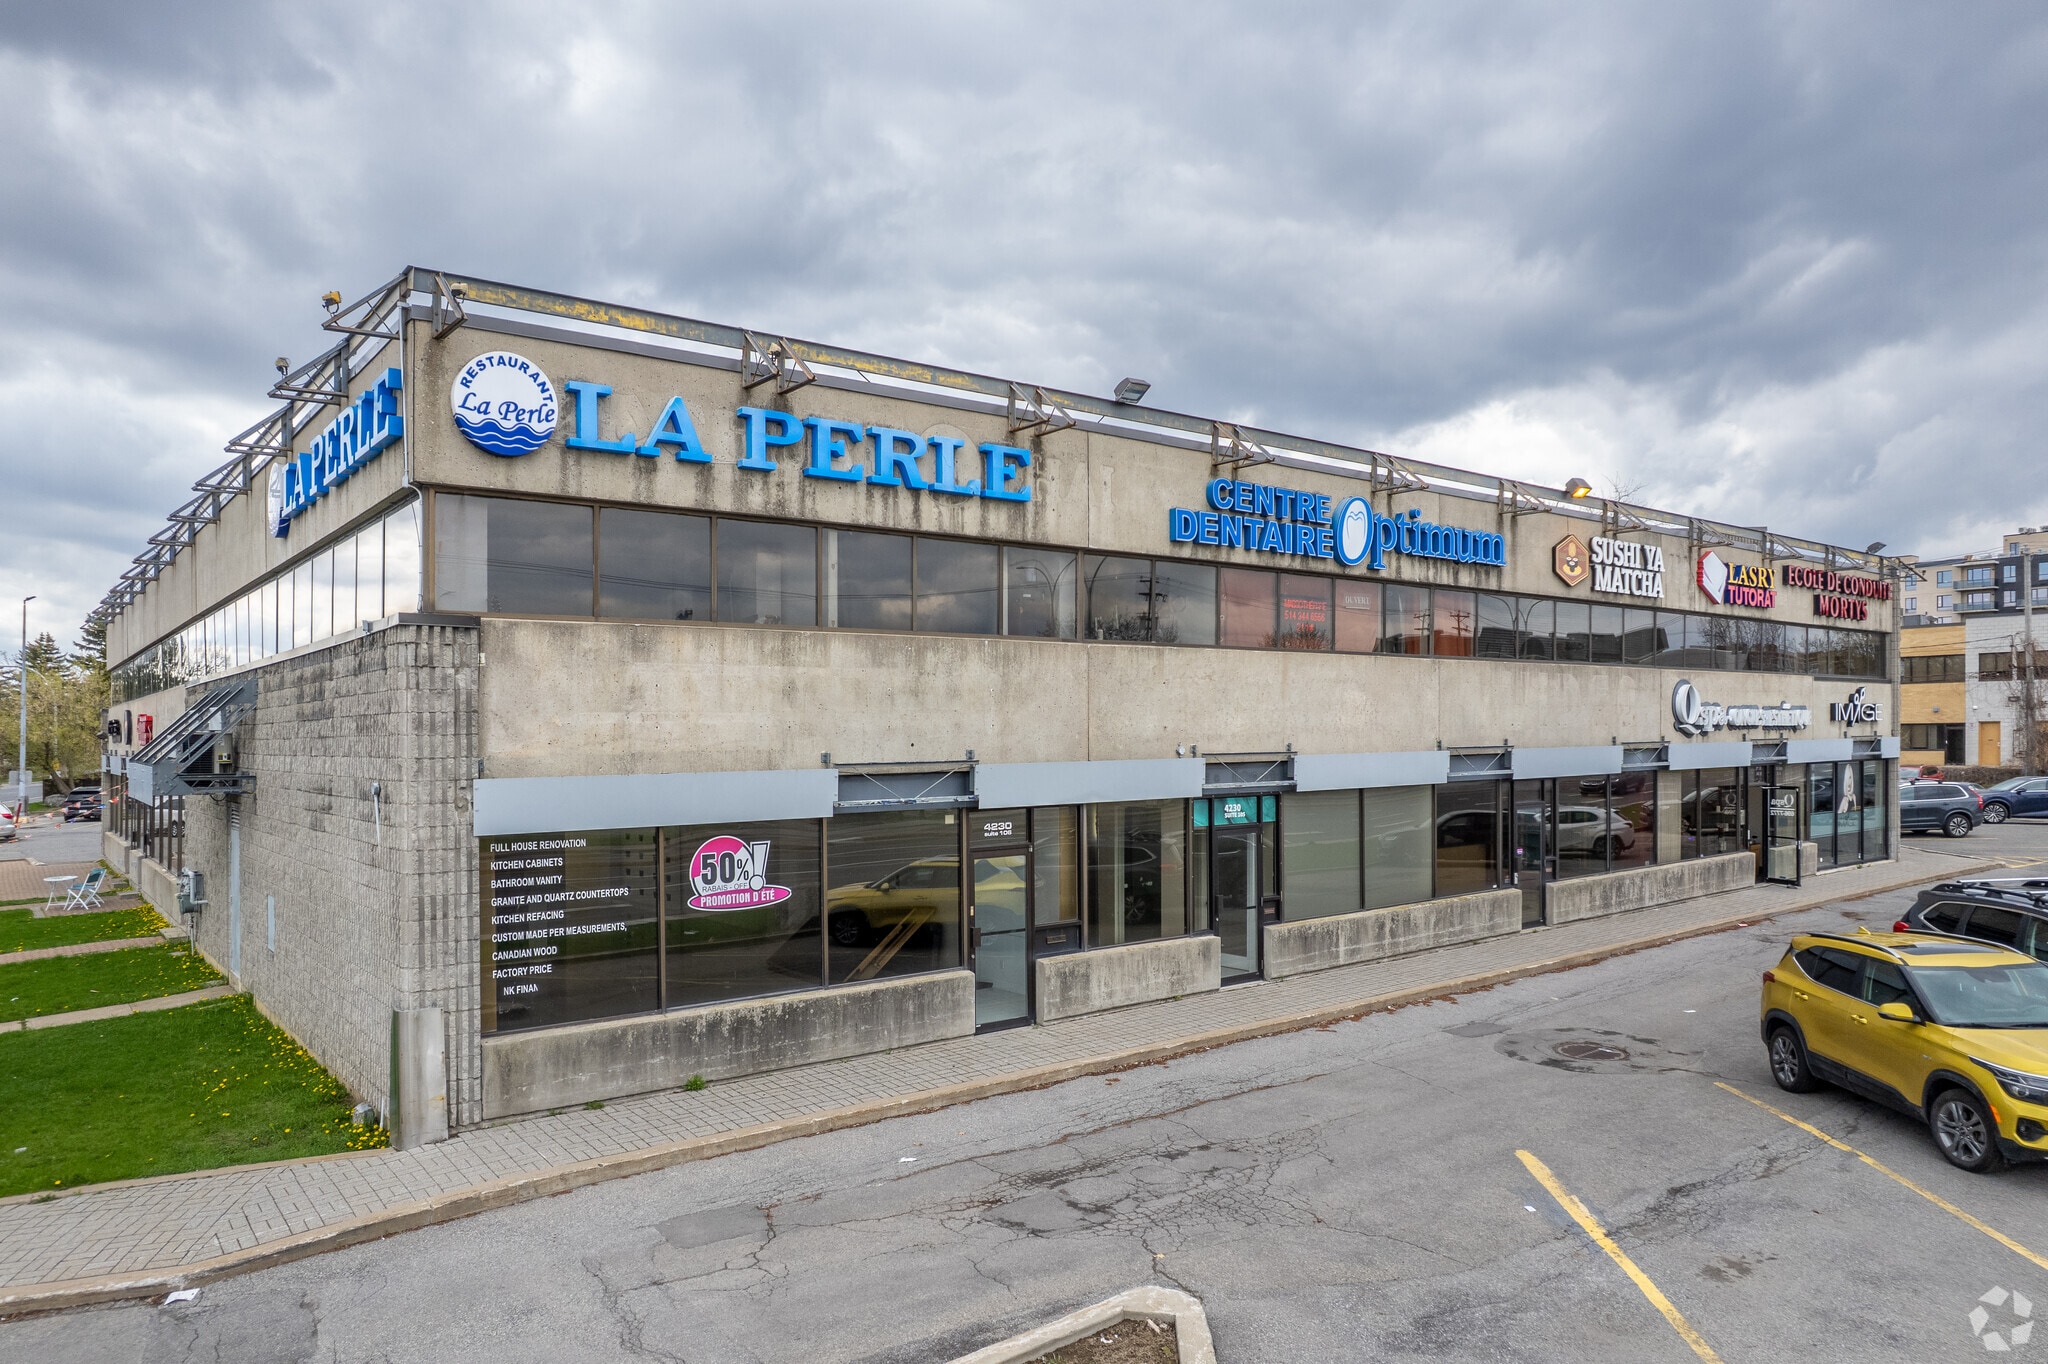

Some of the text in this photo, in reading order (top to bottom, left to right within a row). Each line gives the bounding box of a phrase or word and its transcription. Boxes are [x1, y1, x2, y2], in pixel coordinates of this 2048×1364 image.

[460, 356, 554, 403] RESTAURANT
[458, 392, 555, 424] La Perle
[282, 368, 403, 518] LA PERLE
[564, 381, 712, 463] LA
[736, 405, 1032, 501] PERLE
[1206, 477, 1332, 524] CENTRE
[1170, 507, 1334, 559] DENTAIRE
[1332, 496, 1507, 570] Optimum
[1591, 536, 1665, 573] SUSHI YA
[1593, 563, 1665, 598] MATCHA
[1726, 562, 1777, 589] LASRY
[1784, 565, 1893, 600] ECOLE DE CONDUITE
[1345, 595, 1370, 606] OUVERT
[1726, 585, 1777, 608] TUTORAT
[1816, 594, 1868, 621] MORTYS
[1832, 687, 1884, 727] IMAGE
[1224, 804, 1241, 812] 4230
[984, 822, 1012, 831] 4230
[490, 839, 586, 852] FULL HOUSE RENOVATION
[490, 857, 563, 870] KITCHEN CABINETS
[701, 852, 749, 885] 50%
[491, 875, 562, 888] BATHROOM VANITY
[702, 884, 728, 893] RABAIS
[733, 882, 748, 890] OFF
[491, 887, 629, 907] GRANITE AND QUARTZ COUNTERTOPS
[701, 887, 775, 907] PROMOTION D'ÉTÉ
[491, 910, 564, 925] KITCHEN REFACING
[492, 922, 627, 943] CUSTOM MADE PER MEASUREMENTS,
[492, 946, 557, 960] CANADIAN WOOD
[492, 964, 552, 979] FACTORY PRICE
